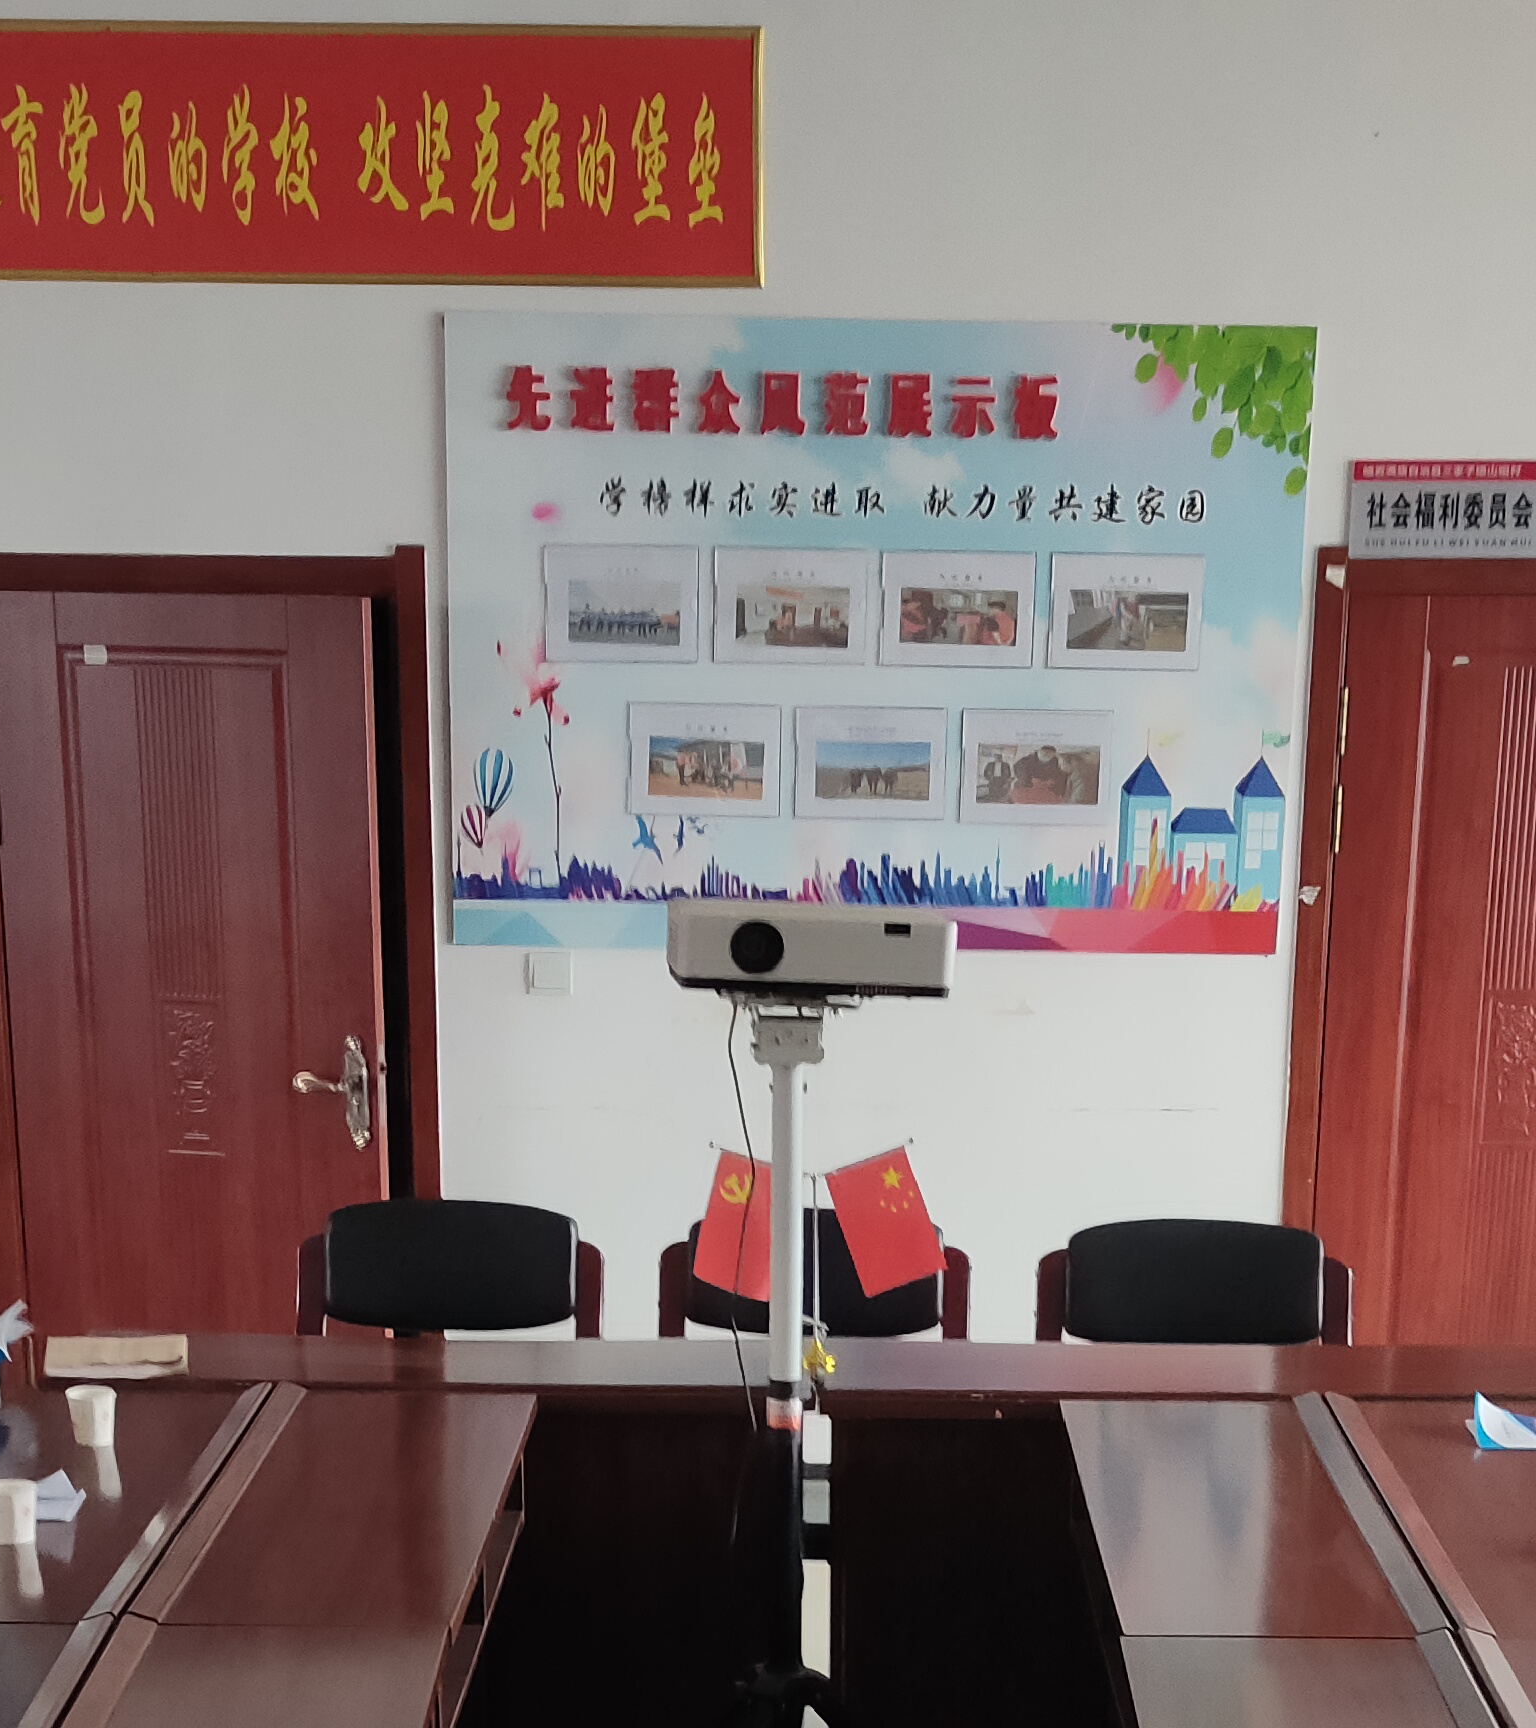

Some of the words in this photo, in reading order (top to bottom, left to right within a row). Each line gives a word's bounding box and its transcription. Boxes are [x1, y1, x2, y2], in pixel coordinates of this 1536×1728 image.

[358, 84, 724, 232] 攻坚克难的堡垒
[502, 364, 1061, 441] 先进群众风范展示板
[598, 476, 886, 518] 学榜样求实进取
[923, 484, 1209, 526] 献力量共建家园
[1366, 490, 1534, 531] 社会福利委员会
